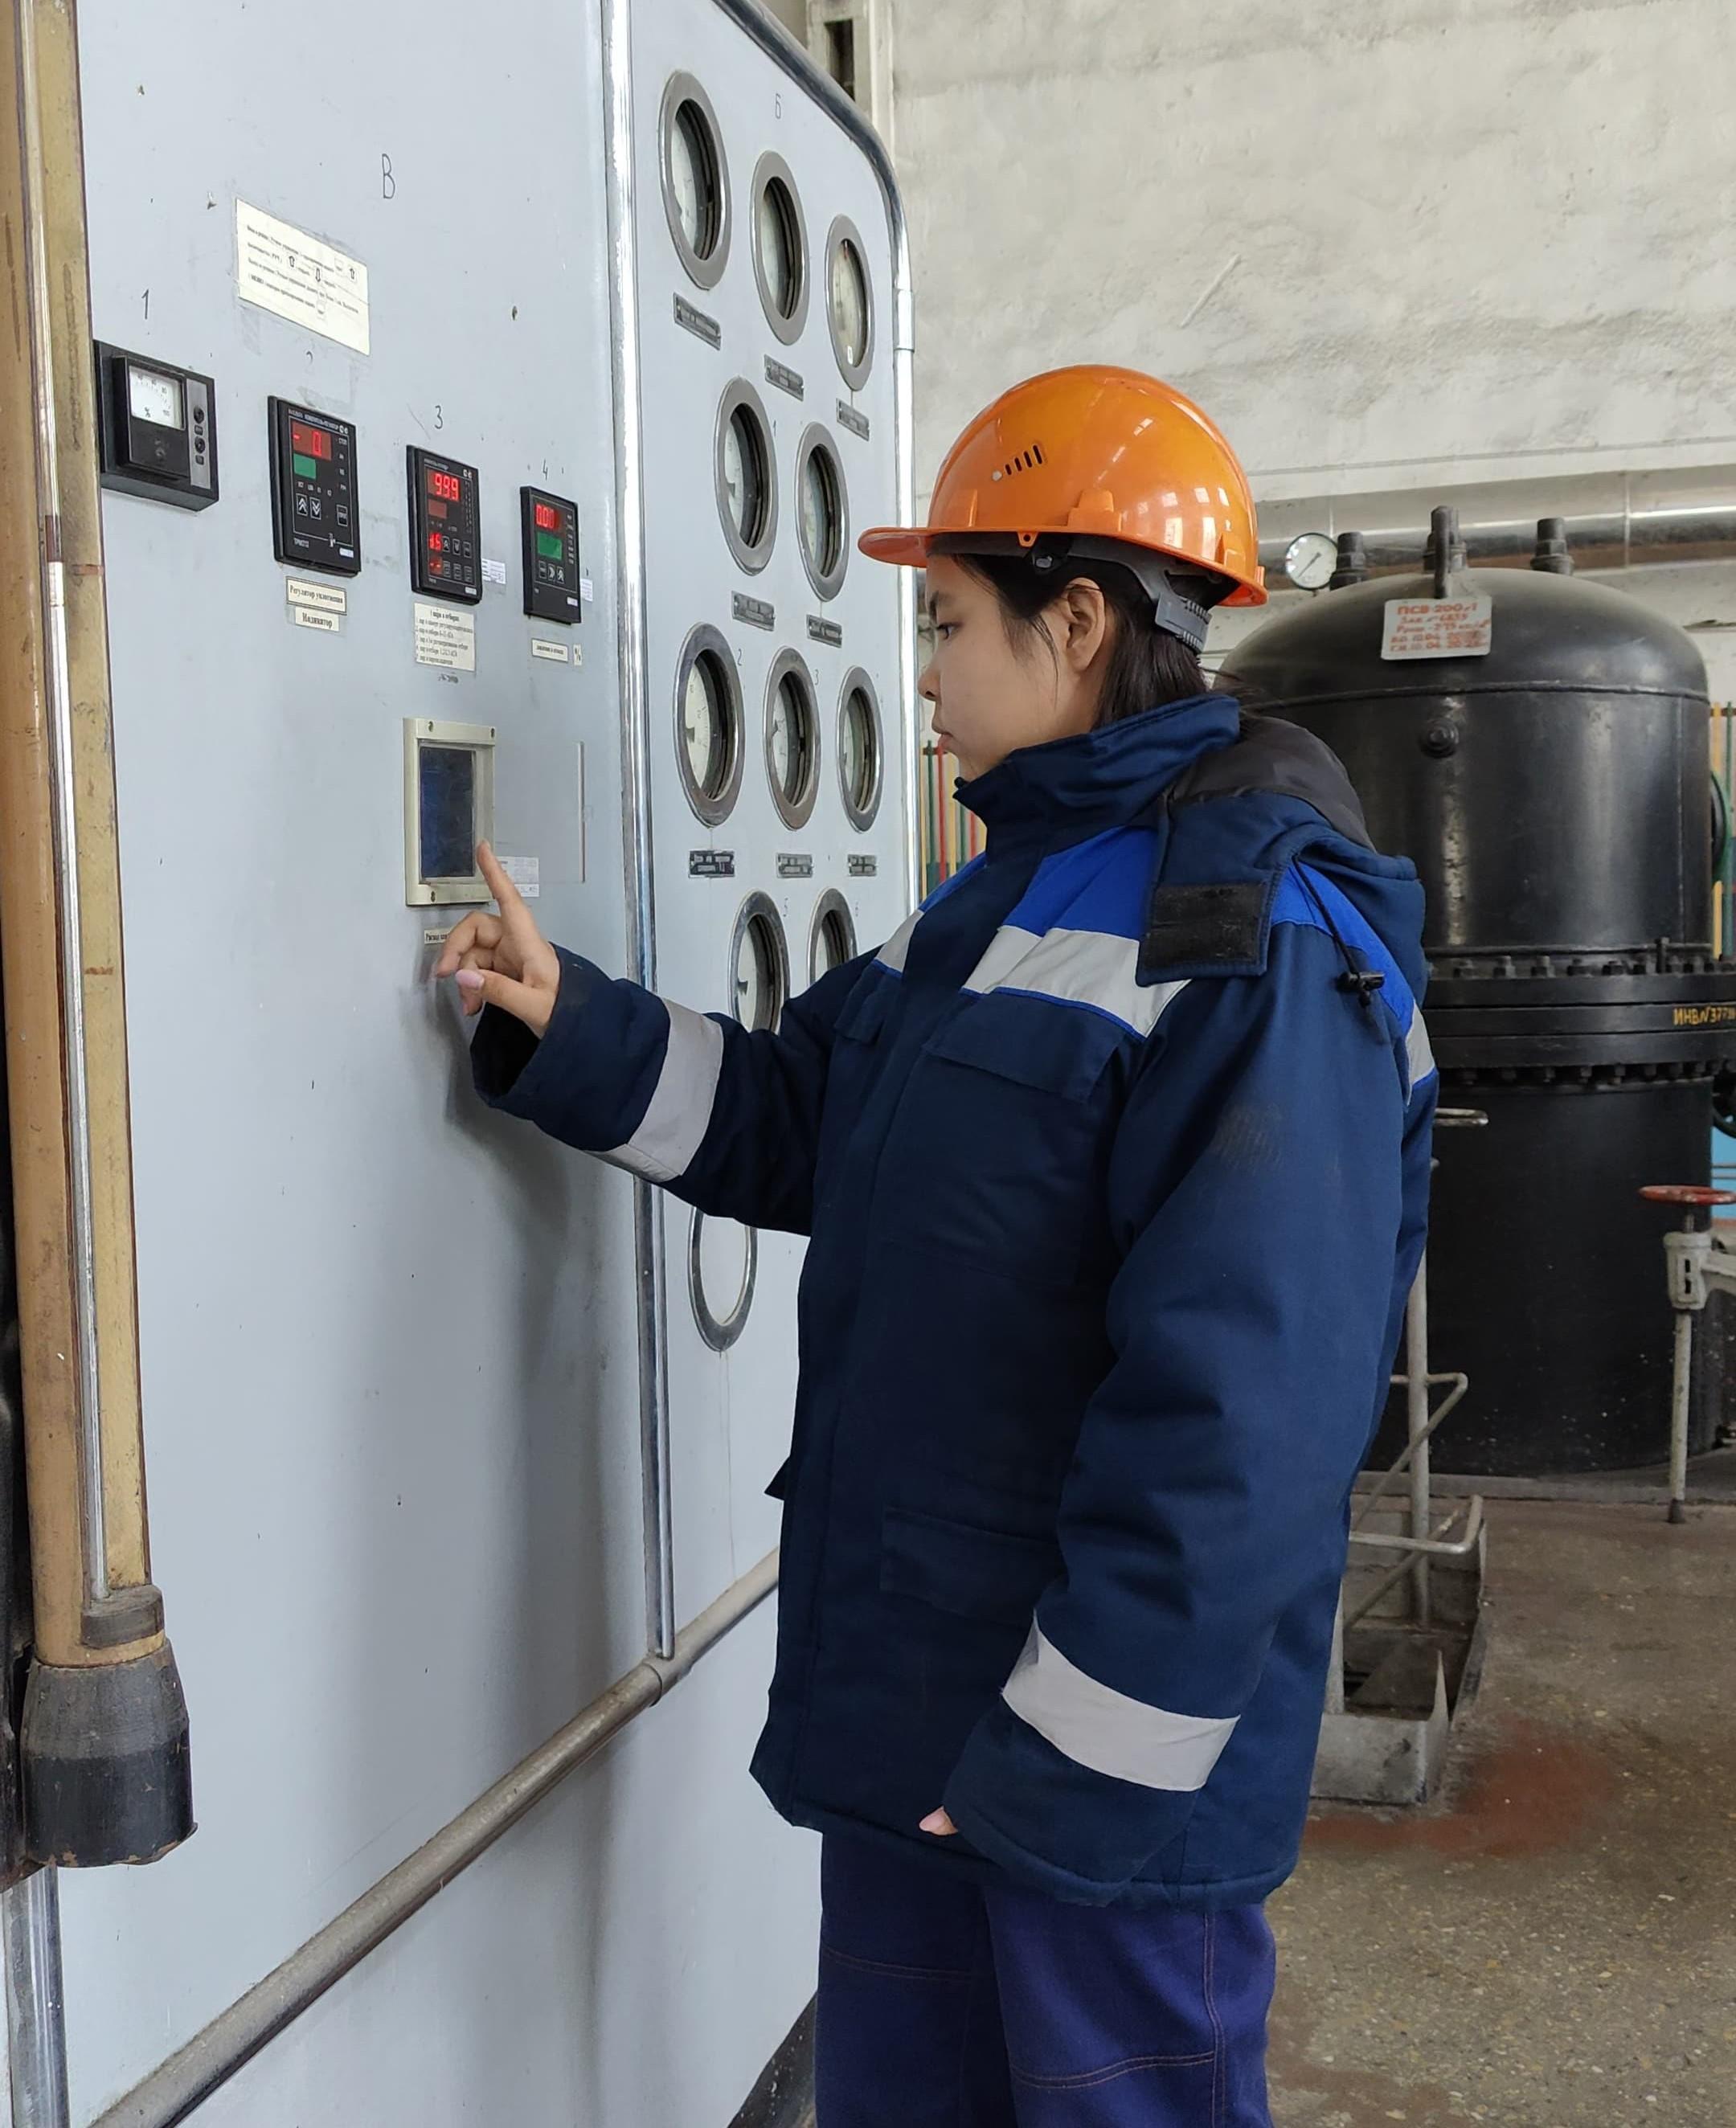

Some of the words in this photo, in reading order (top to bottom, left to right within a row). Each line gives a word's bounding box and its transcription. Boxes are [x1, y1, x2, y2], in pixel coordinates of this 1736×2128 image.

[141, 289, 149, 319] 1
[435, 405, 443, 429] 3
[542, 459, 549, 480] 4
[434, 473, 459, 502] 999
[289, 585, 315, 600] Регулятор
[302, 612, 333, 628] Индикатор
